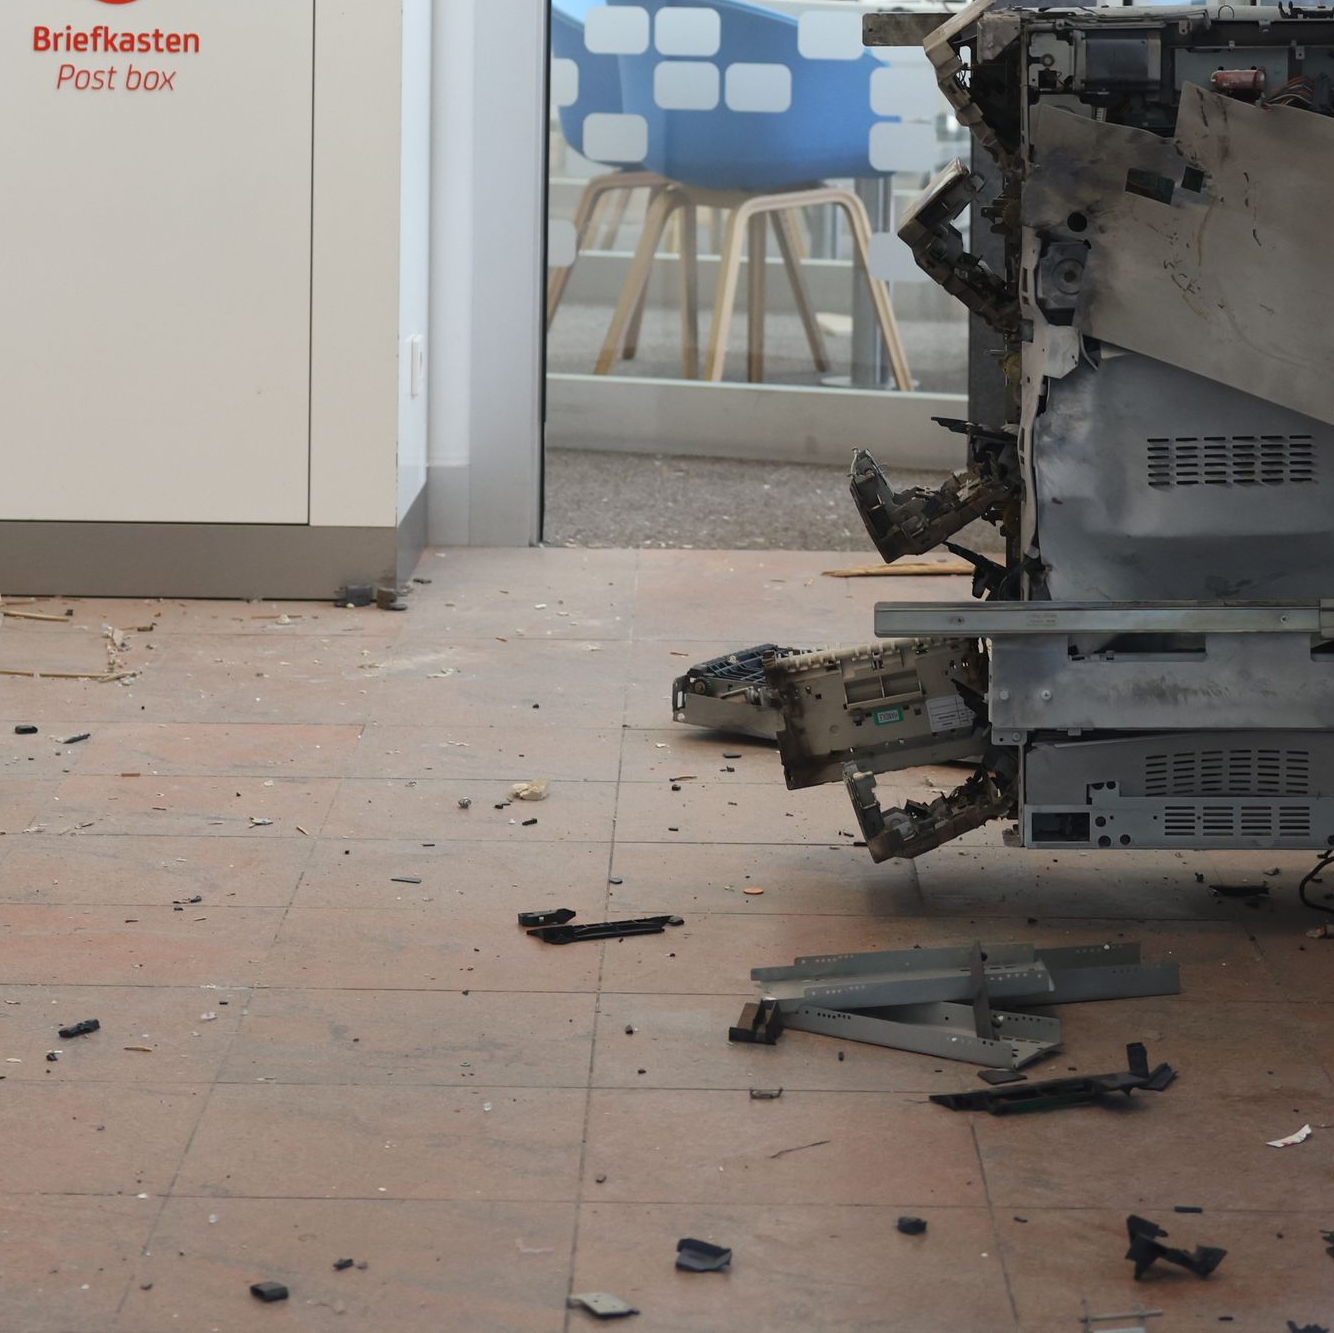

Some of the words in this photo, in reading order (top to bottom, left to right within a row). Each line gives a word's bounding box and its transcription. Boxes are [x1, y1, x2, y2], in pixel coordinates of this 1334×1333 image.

[32, 25, 200, 53] Briefkasten
[56, 64, 117, 91] Post
[125, 64, 176, 91] box
